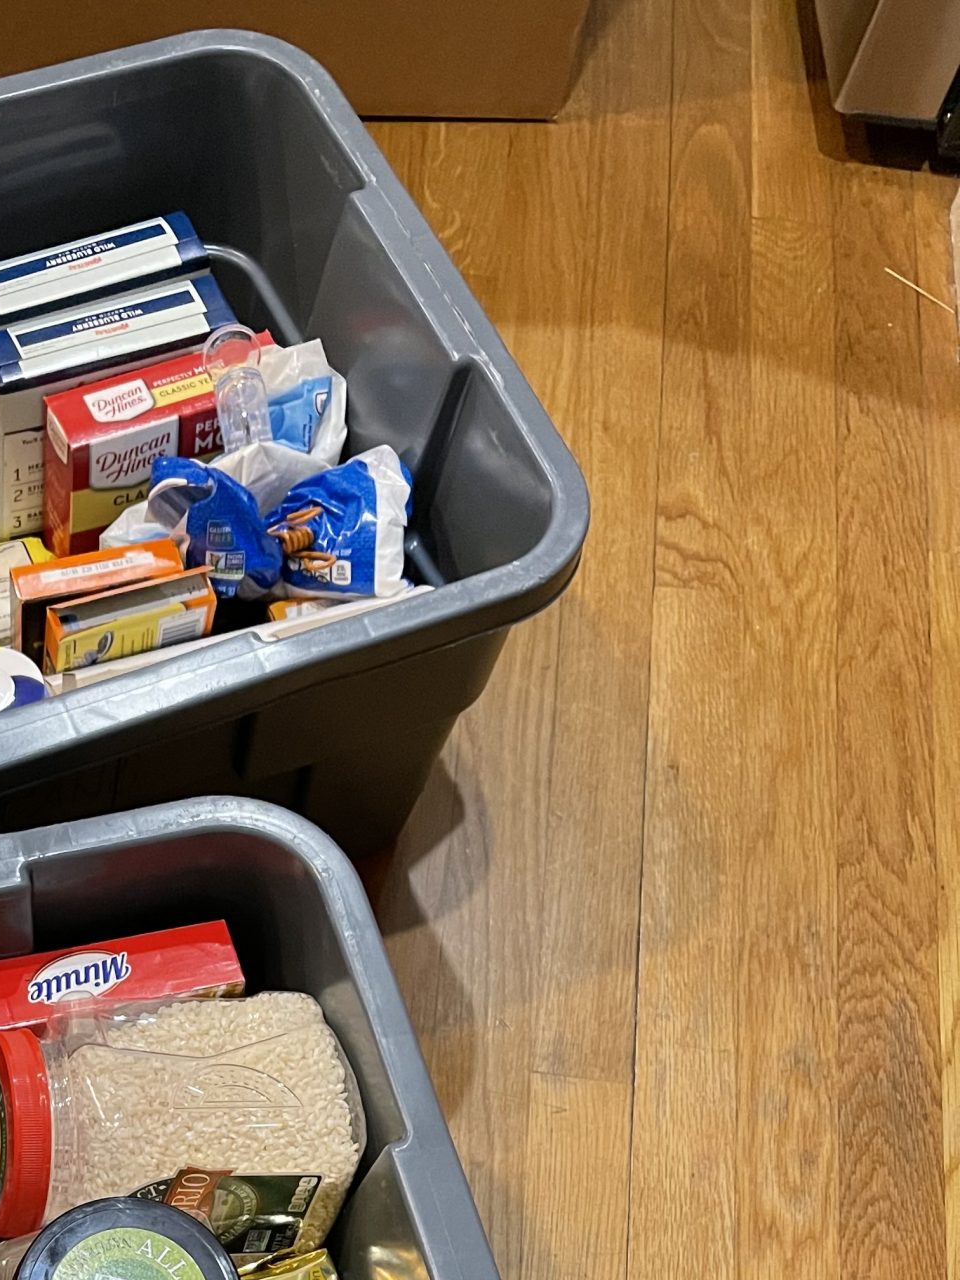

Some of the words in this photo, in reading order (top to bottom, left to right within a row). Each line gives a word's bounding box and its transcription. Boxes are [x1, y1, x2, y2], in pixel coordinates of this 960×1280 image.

[94, 242, 116, 253] WILD
[45, 248, 92, 267] BLUEBERRY
[120, 308, 143, 319] WILD
[72, 314, 119, 332] BLUEBERRY
[152, 371, 192, 387] PERFECTLY
[92, 386, 142, 411] Duncan
[160, 382, 196, 398] CLASSIC
[105, 397, 146, 417] Hines
[96, 432, 171, 472] Duncan
[14, 468, 20, 481] 1
[14, 489, 23, 502] 2
[13, 516, 21, 528] 3
[29, 953, 130, 1003] Minute
[135, 1239, 187, 1280] ALL
